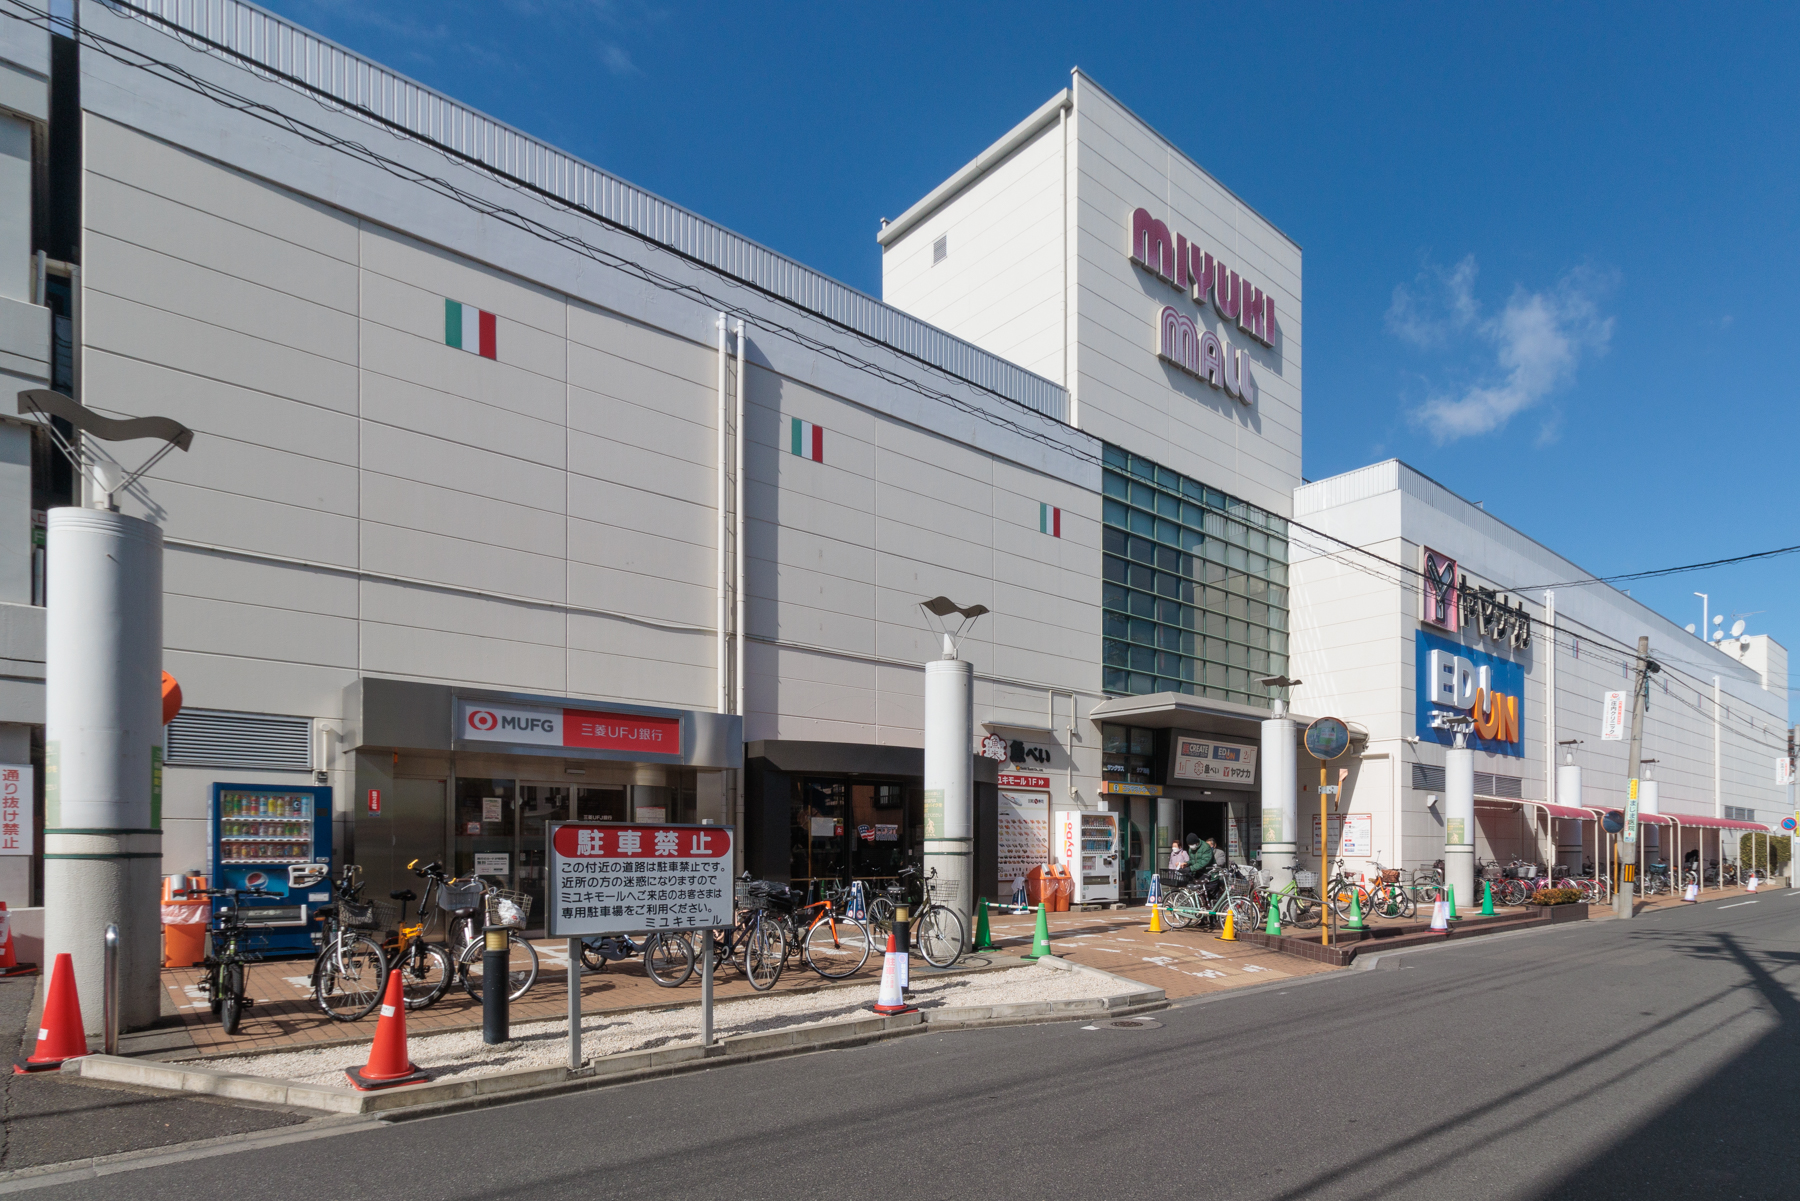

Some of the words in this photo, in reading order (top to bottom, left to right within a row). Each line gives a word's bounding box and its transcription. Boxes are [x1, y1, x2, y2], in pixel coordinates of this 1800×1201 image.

[1128, 207, 1275, 349] MIYUKI
[1156, 306, 1253, 406] MALL
[501, 715, 554, 733] MUFG
[581, 722, 663, 742] 三菱UFJ銀行
[1028, 778, 1037, 786] 1F
[2, 768, 19, 849] 通り抜け禁止
[576, 829, 713, 856] 駐車禁止
[561, 862, 726, 874] この付近の道路は駐車禁止です。
[561, 875, 718, 889] 近所の方の迷惑になりますので
[561, 903, 713, 919] 専用駐車場をご利用ください。
